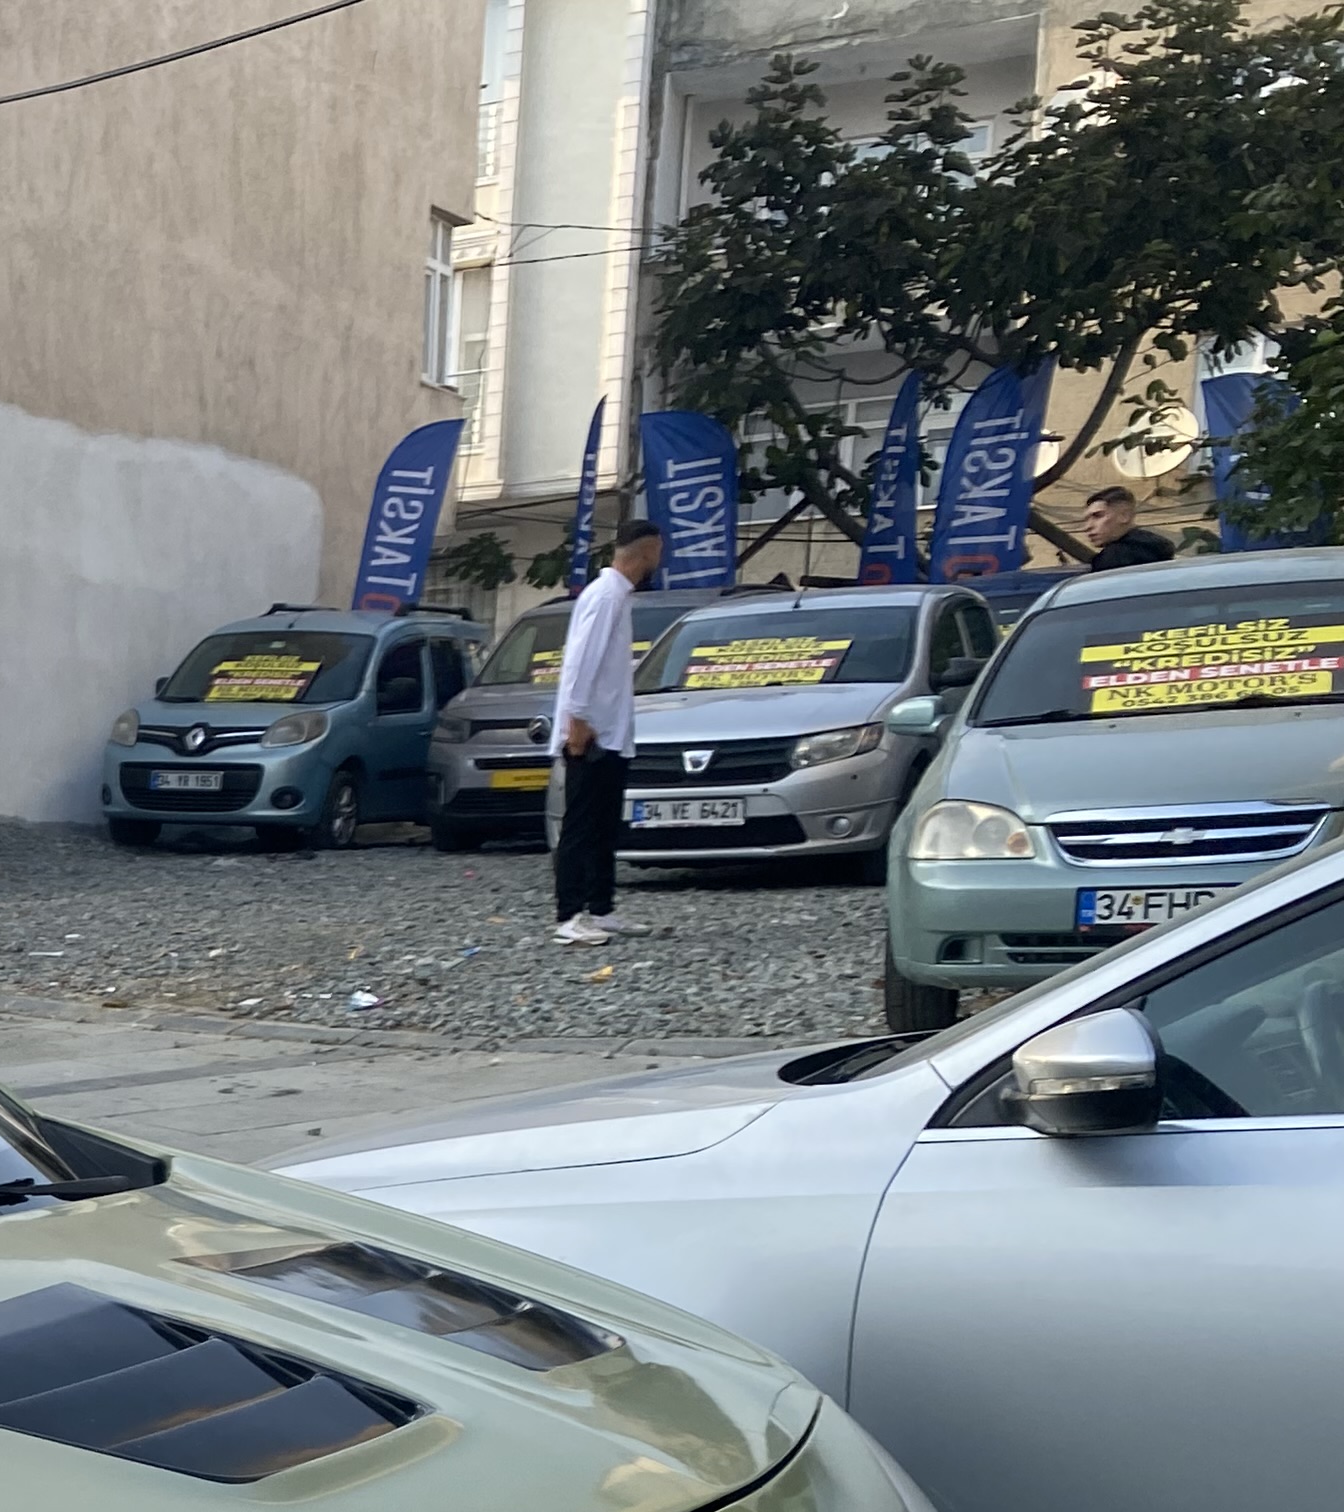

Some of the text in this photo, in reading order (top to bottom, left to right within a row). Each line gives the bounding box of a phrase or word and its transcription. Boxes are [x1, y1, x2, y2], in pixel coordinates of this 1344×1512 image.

[658, 456, 729, 590] TAKSİT
[1123, 630, 1309, 653] KOŞULSUZ
[1142, 618, 1290, 642] KEFİLSİZ
[1088, 656, 1341, 688] ELDEN SENETLE
[1107, 687, 1155, 701] NK
[1096, 893, 1135, 921] 34
